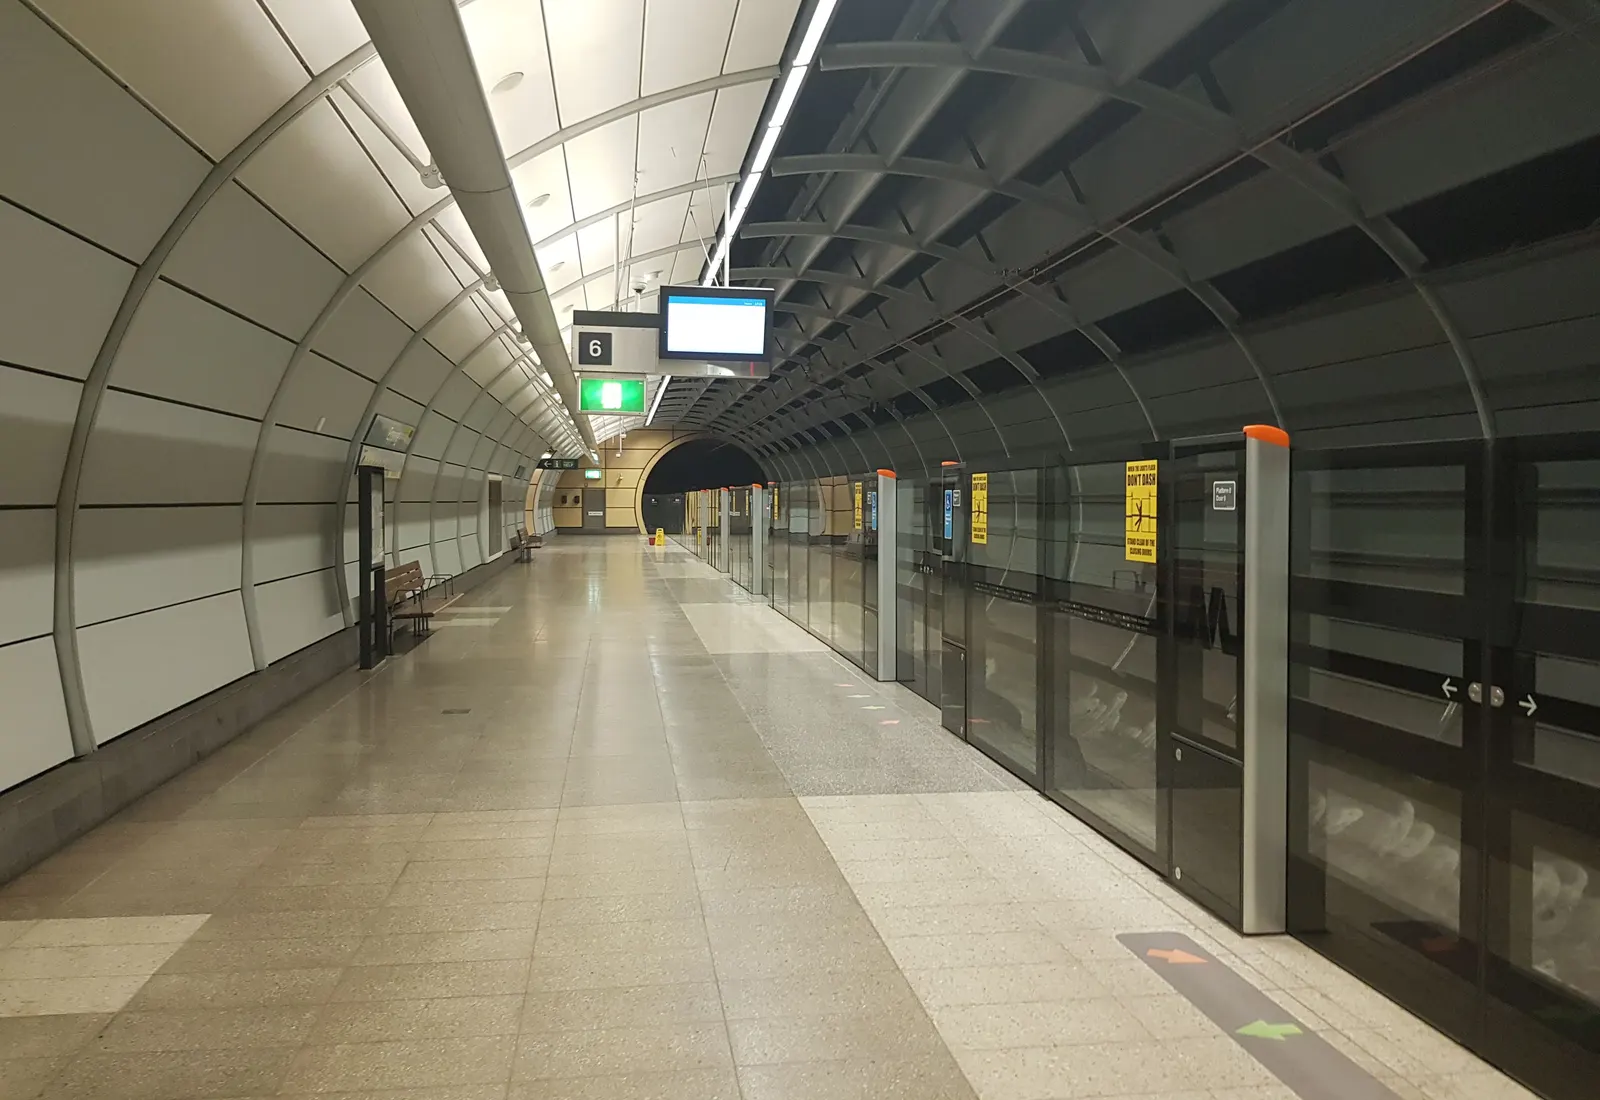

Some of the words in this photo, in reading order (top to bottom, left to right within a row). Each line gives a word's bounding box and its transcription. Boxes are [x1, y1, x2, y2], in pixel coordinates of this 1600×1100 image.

[589, 339, 602, 357] 6
[1128, 474, 1141, 486] DON'T
[1142, 473, 1156, 486] DASH
